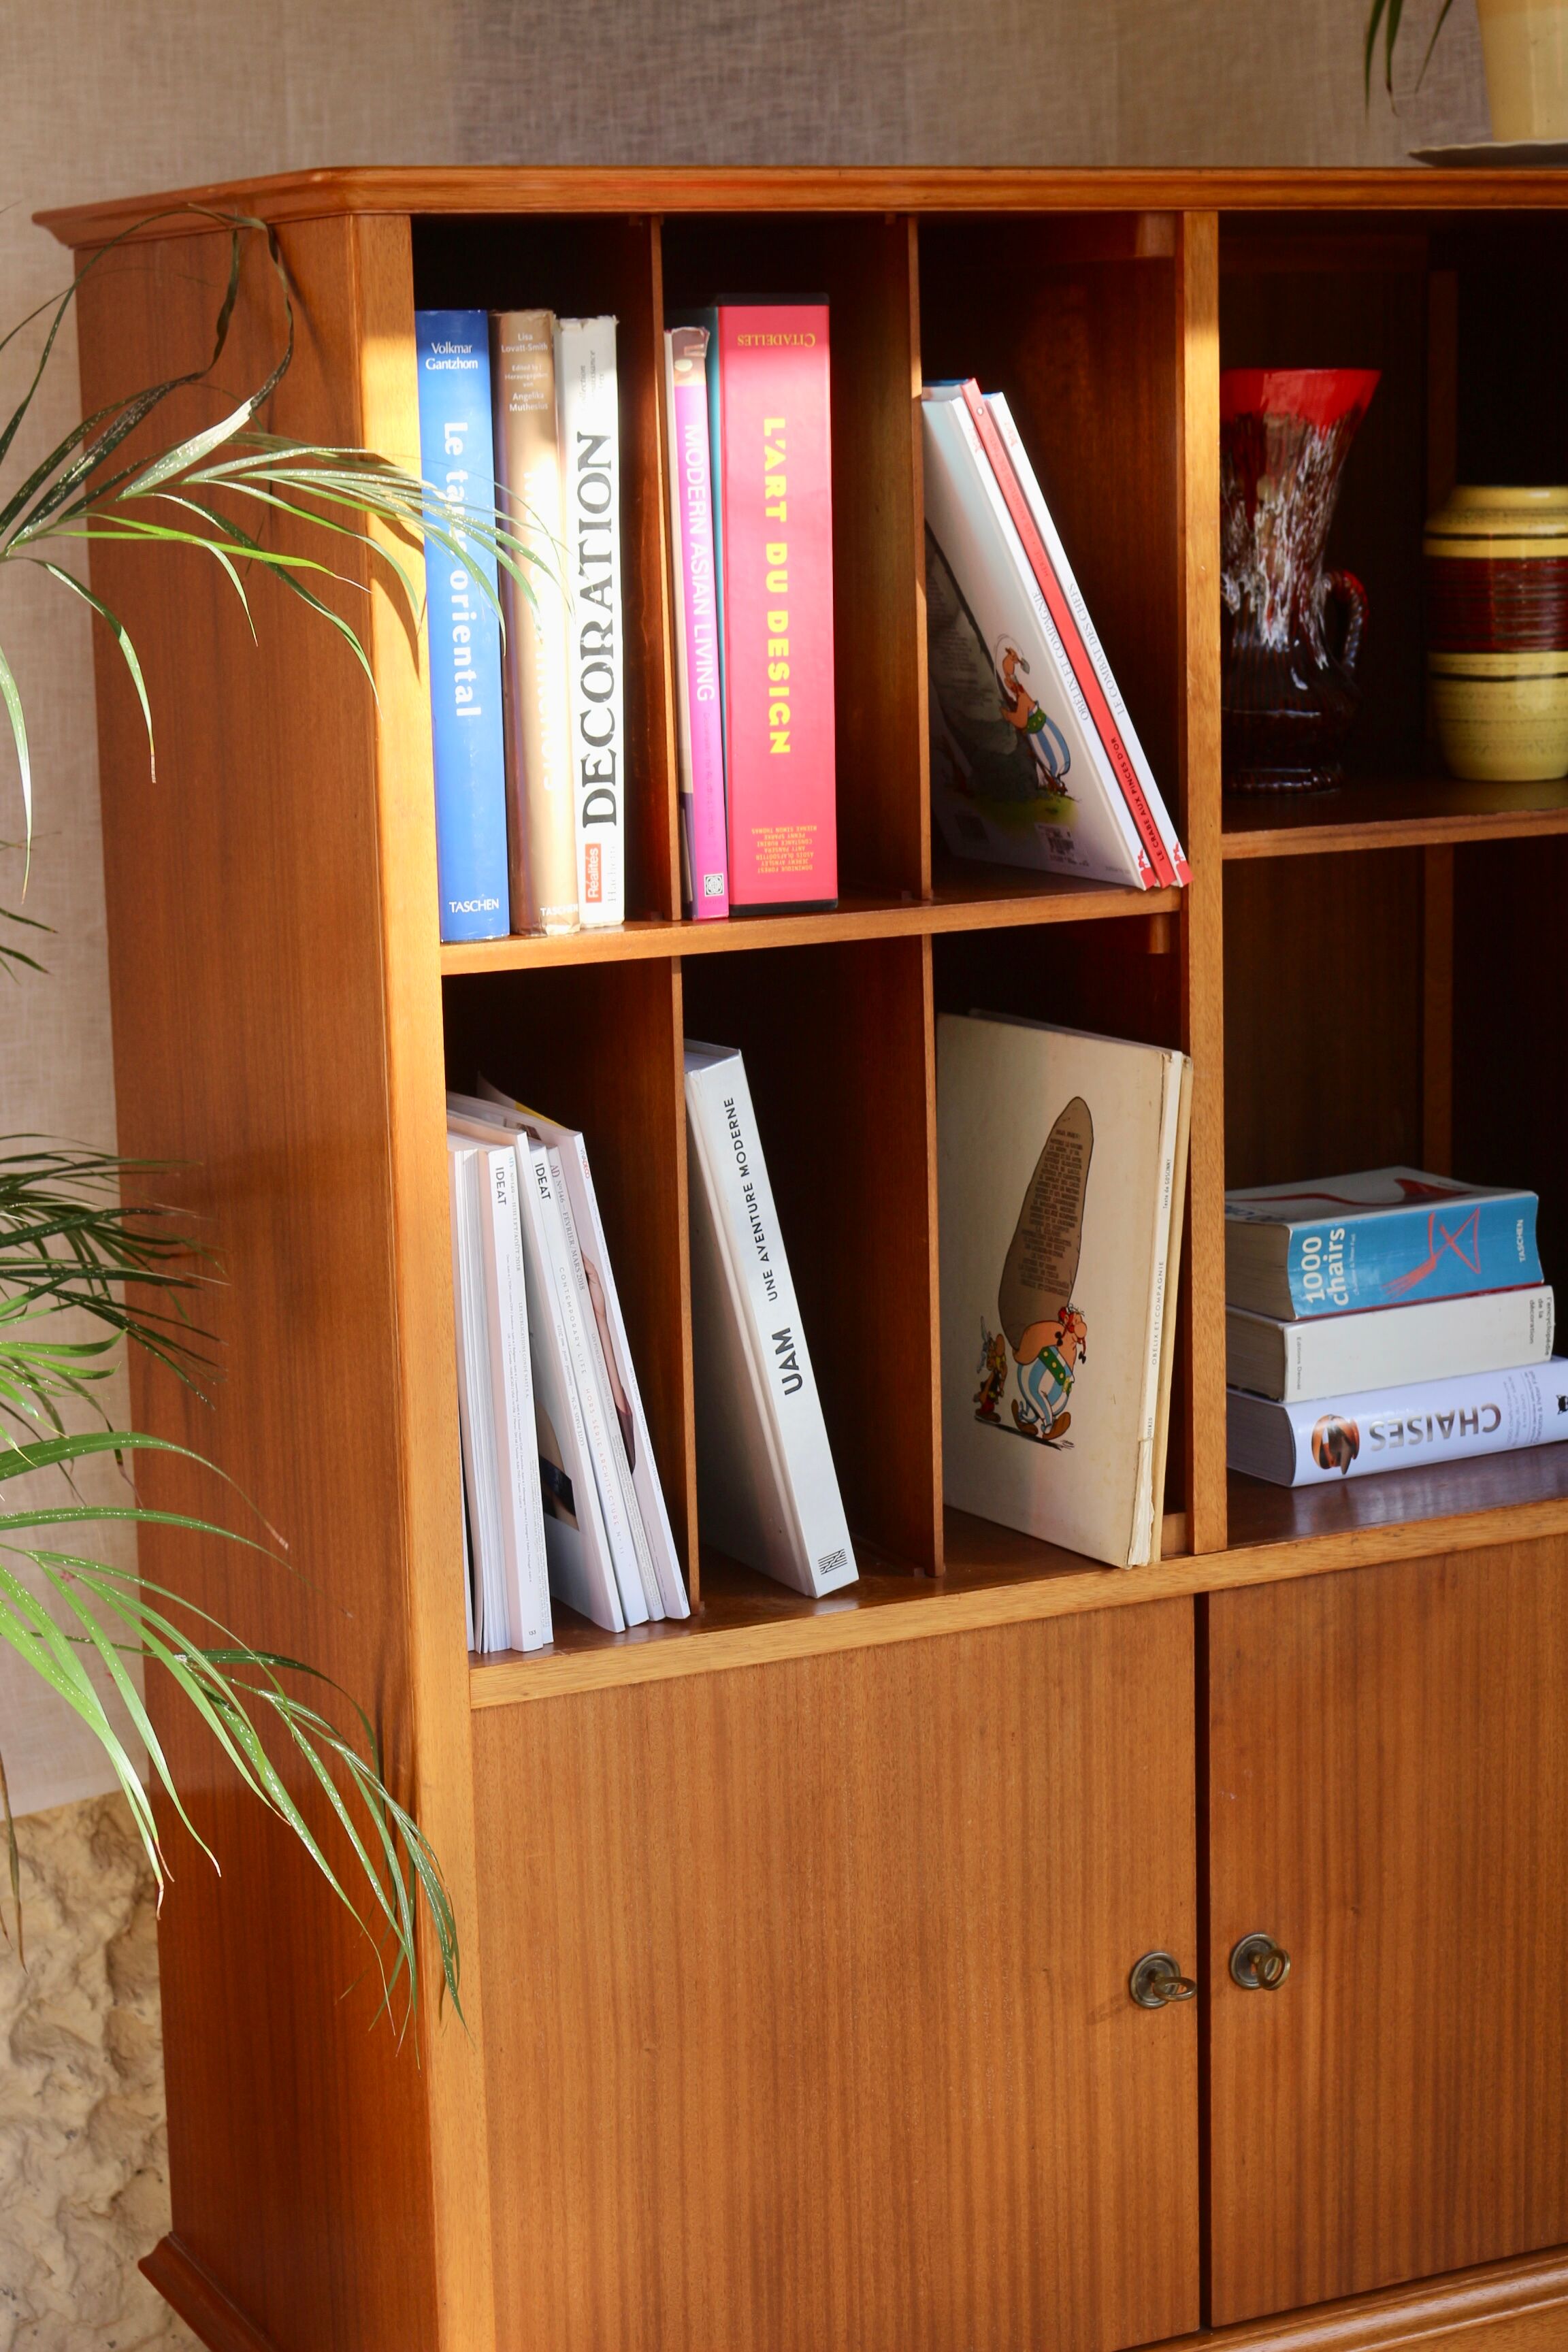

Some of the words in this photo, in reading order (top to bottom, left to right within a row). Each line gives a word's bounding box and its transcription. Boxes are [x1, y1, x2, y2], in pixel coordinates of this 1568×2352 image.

[431, 342, 472, 354] Volkmar
[501, 343, 549, 353] Lovatt-Smith
[738, 333, 815, 347] CITADELLES
[512, 392, 544, 402] Angelika
[444, 422, 468, 456] Le
[684, 424, 706, 534] MODERN
[764, 417, 787, 522] L'ART
[690, 542, 710, 615] ASIAN
[765, 543, 788, 593] DU
[1064, 582, 1090, 622] CHEFS
[449, 570, 482, 717] oriental
[577, 430, 618, 829] DECORATION
[1030, 590, 1066, 659] COMPAGNIE
[1081, 622, 1098, 646] DES
[693, 624, 715, 702] LIVING
[768, 610, 791, 754] DESIGN
[1059, 660, 1073, 676] ET
[1091, 648, 1120, 698] COMBAT
[1113, 699, 1125, 715] LE
[1109, 736, 1124, 760] D'OR
[1119, 761, 1138, 794] PINCES
[1134, 796, 1147, 816] AUX
[1142, 819, 1160, 848] CRABE
[586, 847, 598, 898] Réalités
[1156, 850, 1164, 861] LE
[449, 898, 500, 913] TASCHEN
[540, 904, 578, 916] TASCHEN
[724, 1097, 751, 1177] MODERNE
[495, 1166, 507, 1206] IDEAT
[549, 1163, 561, 1178] AD
[575, 1273, 585, 1290] 2018
[743, 1183, 770, 1262] AVENTURE
[1516, 1220, 1524, 1262] TASCHEN
[763, 1270, 777, 1301] UNE
[1301, 1236, 1325, 1303] 1000
[1323, 1227, 1350, 1306] chairs
[1155, 1260, 1163, 1317] COMPAGNIE
[1538, 1298, 1544, 1309] de
[1154, 1321, 1159, 1330] ET
[1539, 1311, 1544, 1319] la
[533, 1162, 551, 1200] IDEAT
[557, 1267, 581, 1348] CONTEMPORARY
[576, 1353, 586, 1375] LIFE
[584, 1388, 604, 1448] HORS-SÉRIE
[598, 1452, 620, 1526] ARCHITECTURE
[772, 1327, 803, 1394] UAM
[1369, 1403, 1501, 1451] CHAISES
